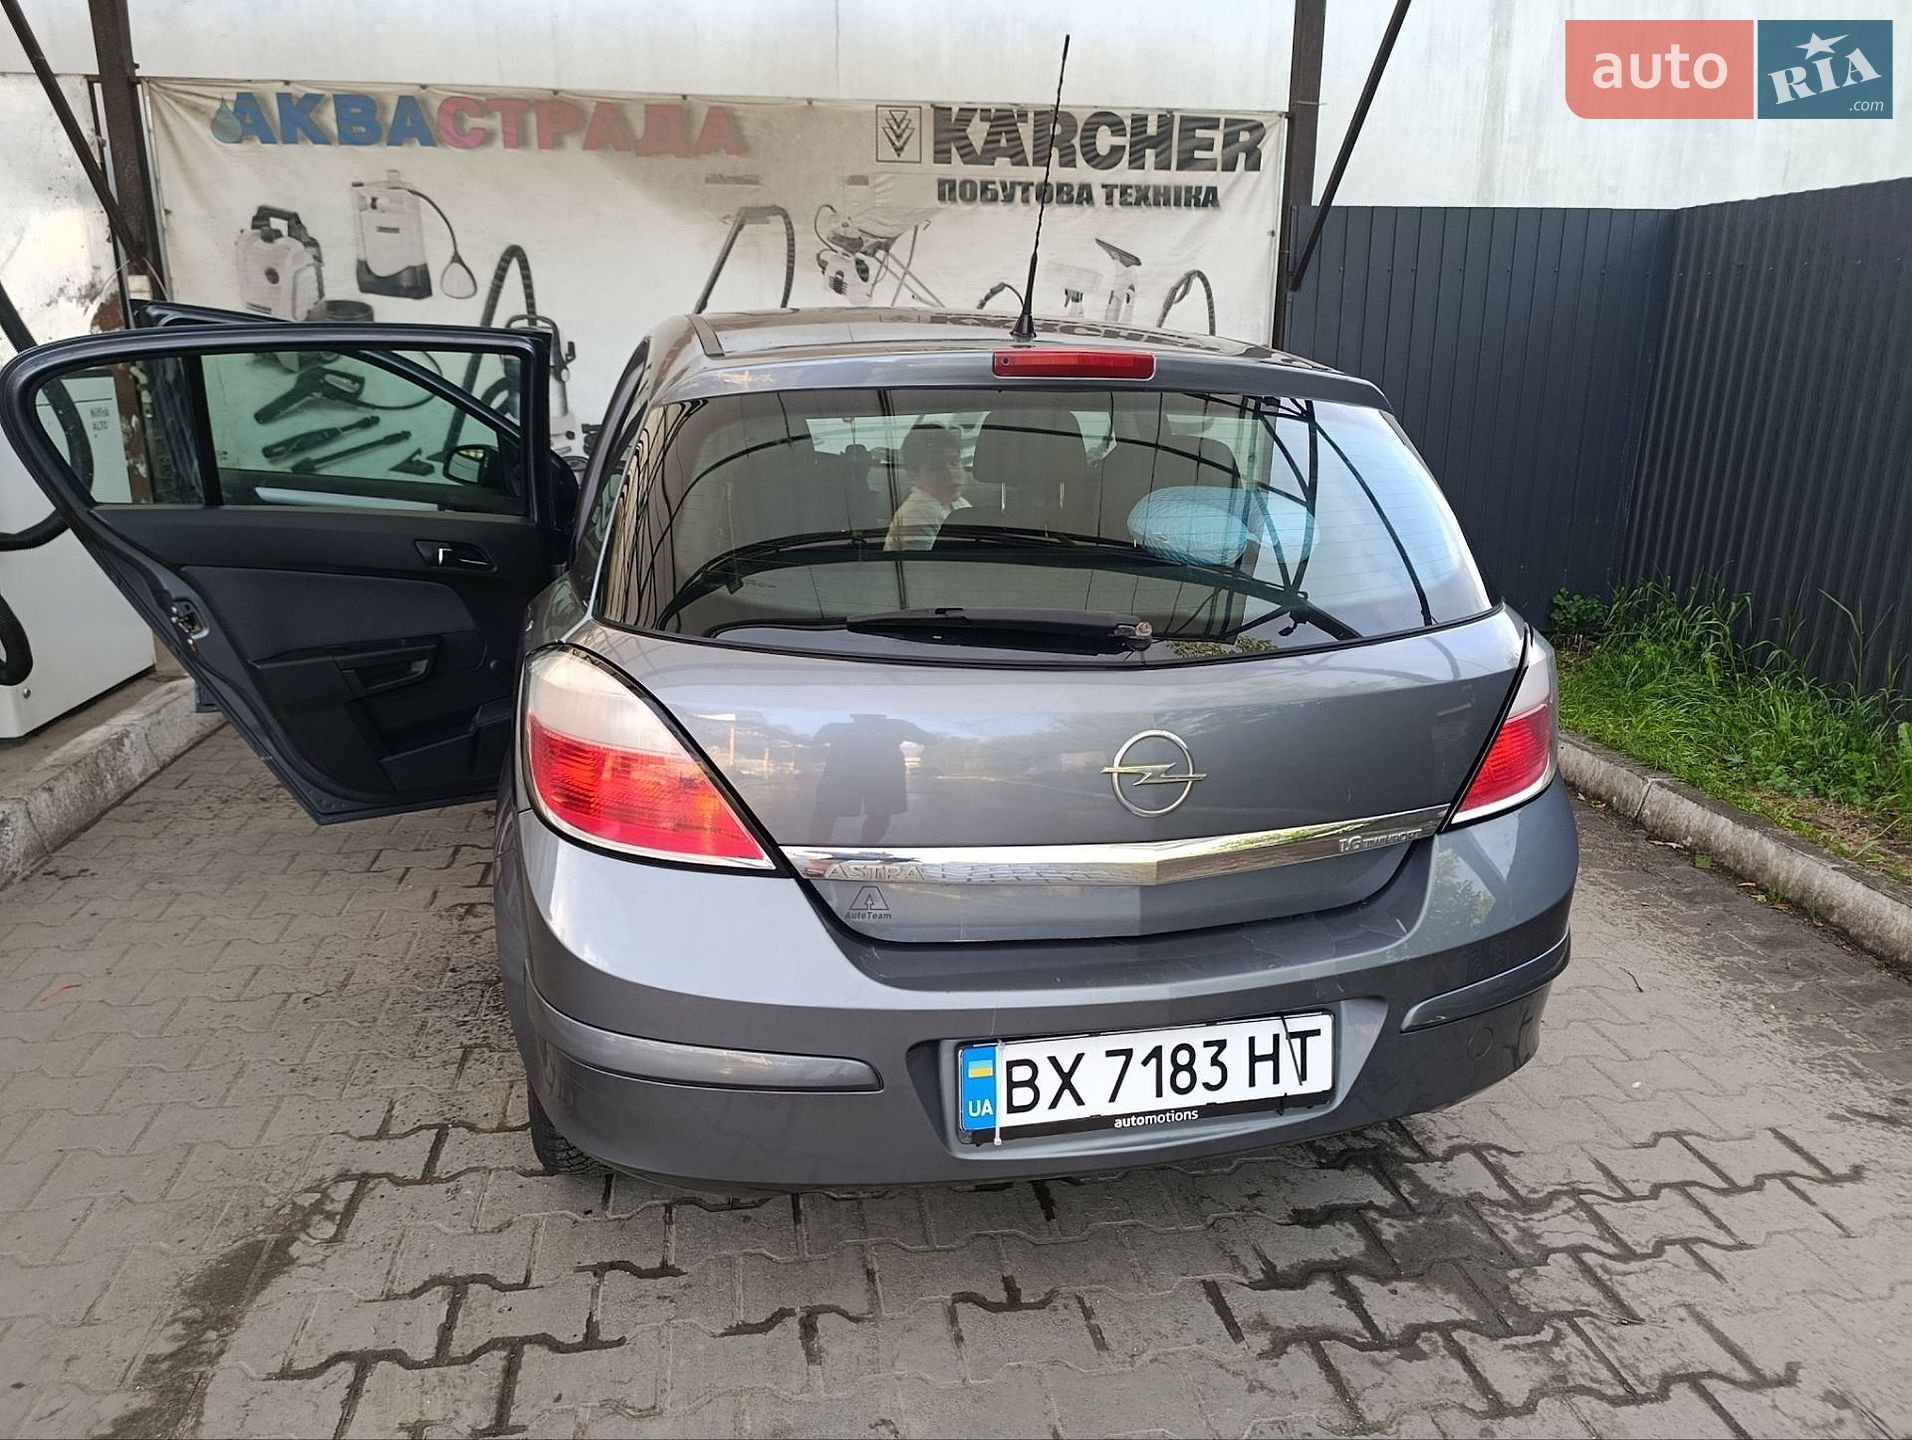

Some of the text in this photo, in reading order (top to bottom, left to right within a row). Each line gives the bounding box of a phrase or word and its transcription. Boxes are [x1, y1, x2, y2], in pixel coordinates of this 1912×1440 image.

[233, 92, 742, 158] АКВАСТРАДА
[938, 178, 1220, 208] ПОБУТОВА ТЕХНІКА
[824, 864, 925, 880] ASTRA
[1006, 1028, 1321, 1114] BX 7183 HT
[968, 1098, 993, 1117] UA
[1114, 1108, 1198, 1128] automotions
